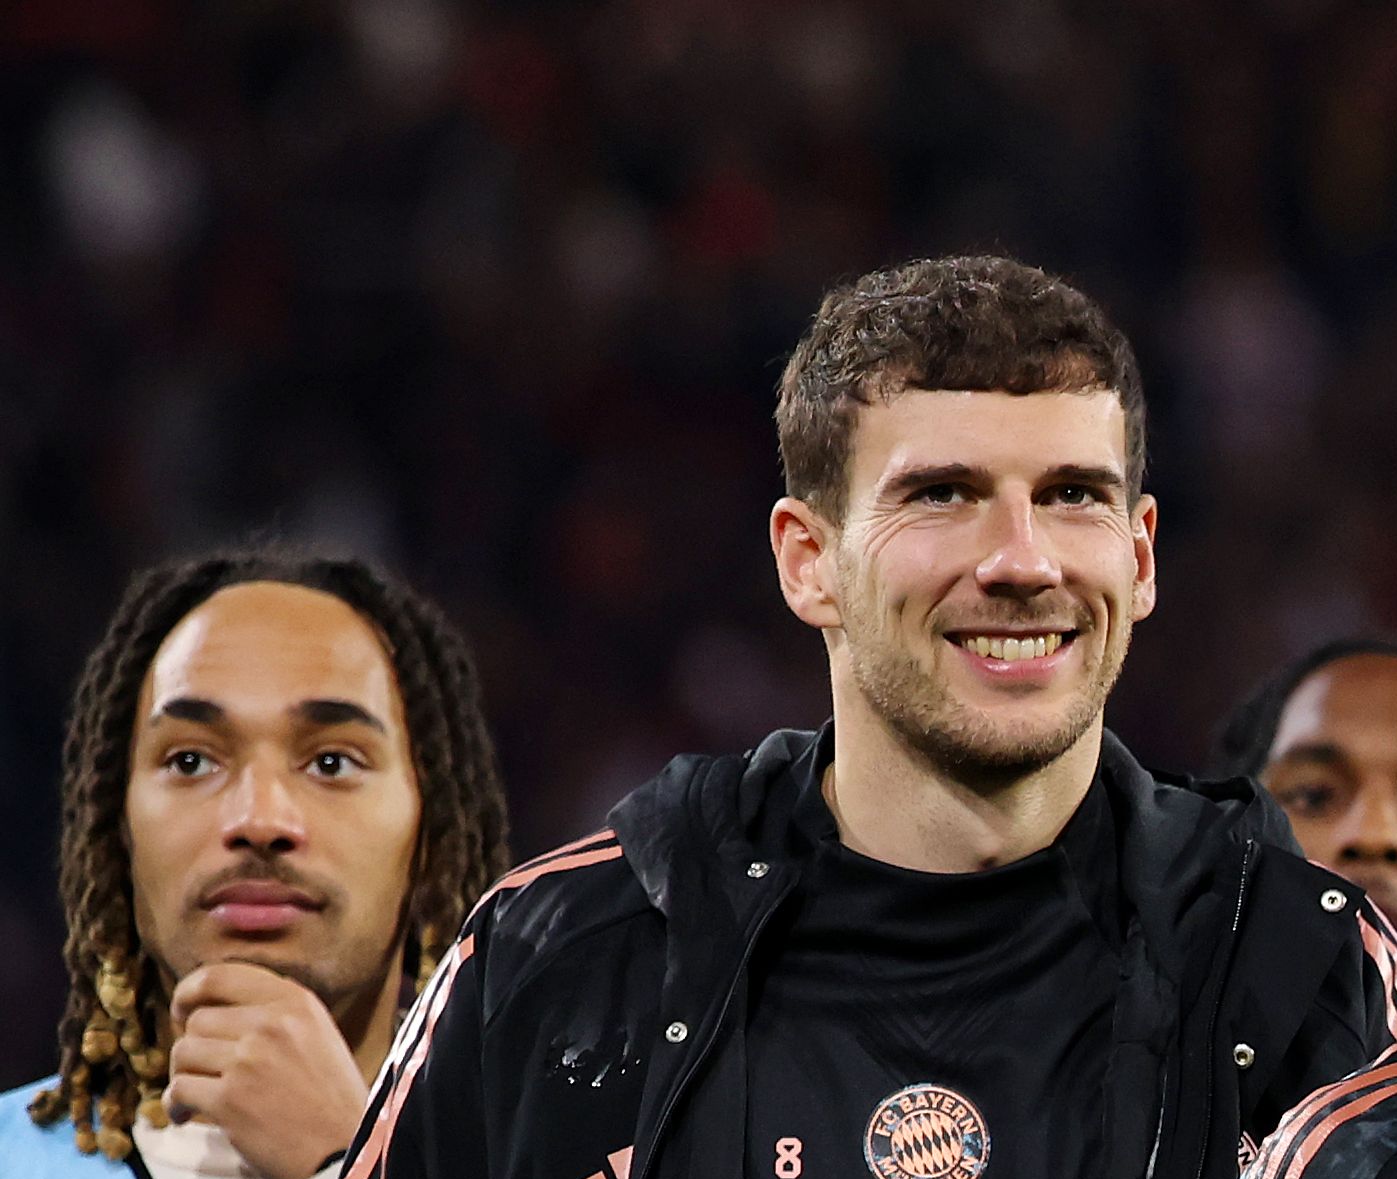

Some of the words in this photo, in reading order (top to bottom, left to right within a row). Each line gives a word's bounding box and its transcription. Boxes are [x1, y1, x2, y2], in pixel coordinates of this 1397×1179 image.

[875, 1109, 898, 1138] FC
[899, 1092, 981, 1135] BAYERN
[775, 1137, 802, 1179] 8
